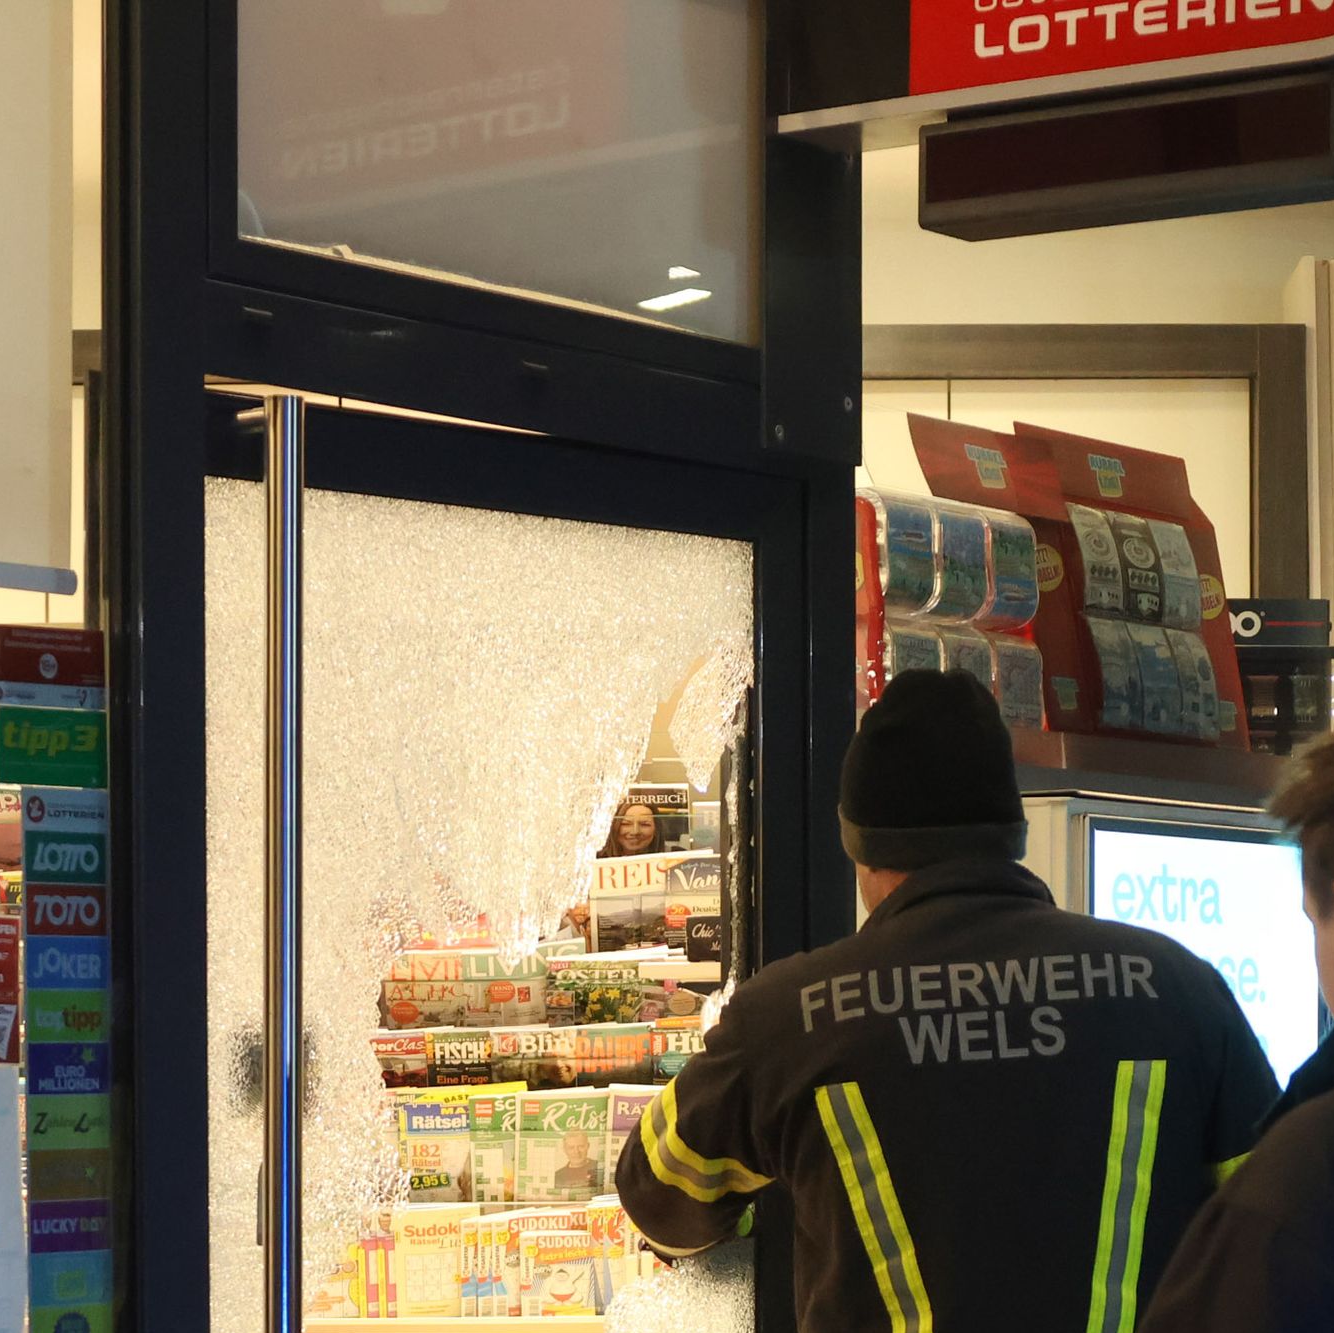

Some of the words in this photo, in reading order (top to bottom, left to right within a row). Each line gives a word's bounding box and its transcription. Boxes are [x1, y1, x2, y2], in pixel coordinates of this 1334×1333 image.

[3, 720, 99, 758] tipp3
[33, 842, 100, 874] LOTTO
[1111, 863, 1223, 925] extra
[34, 893, 101, 927] TOTO
[33, 947, 101, 980] JOKER
[800, 953, 1159, 1033] FEUERWEHR
[898, 1005, 1067, 1065] WELS
[436, 1075, 459, 1084] Eine
[460, 1075, 489, 1086] Frage
[410, 1144, 441, 1158] 182
[411, 1157, 442, 1168] Rätsel
[410, 1174, 440, 1190] 2,95
[439, 1174, 449, 1186] €
[33, 1217, 78, 1235] LUCKY
[508, 1214, 568, 1233] SUDOKU
[537, 1235, 591, 1249] SUDOKU
